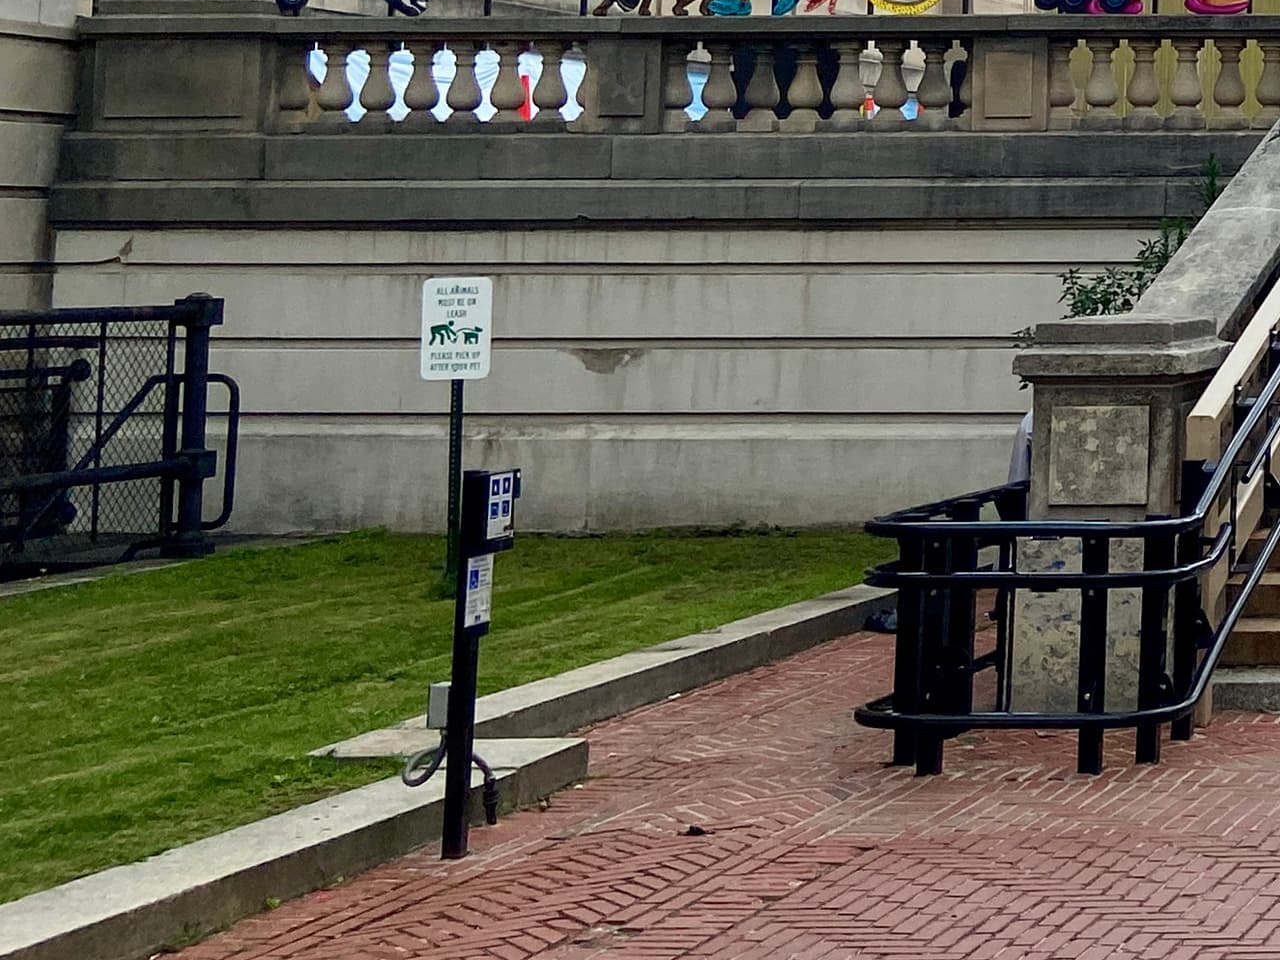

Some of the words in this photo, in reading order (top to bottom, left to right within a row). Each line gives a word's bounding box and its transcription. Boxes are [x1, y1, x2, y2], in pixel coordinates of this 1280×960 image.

[437, 287, 448, 295] ALL
[447, 310, 467, 318] LEASH
[430, 352, 453, 360] PLEASE
